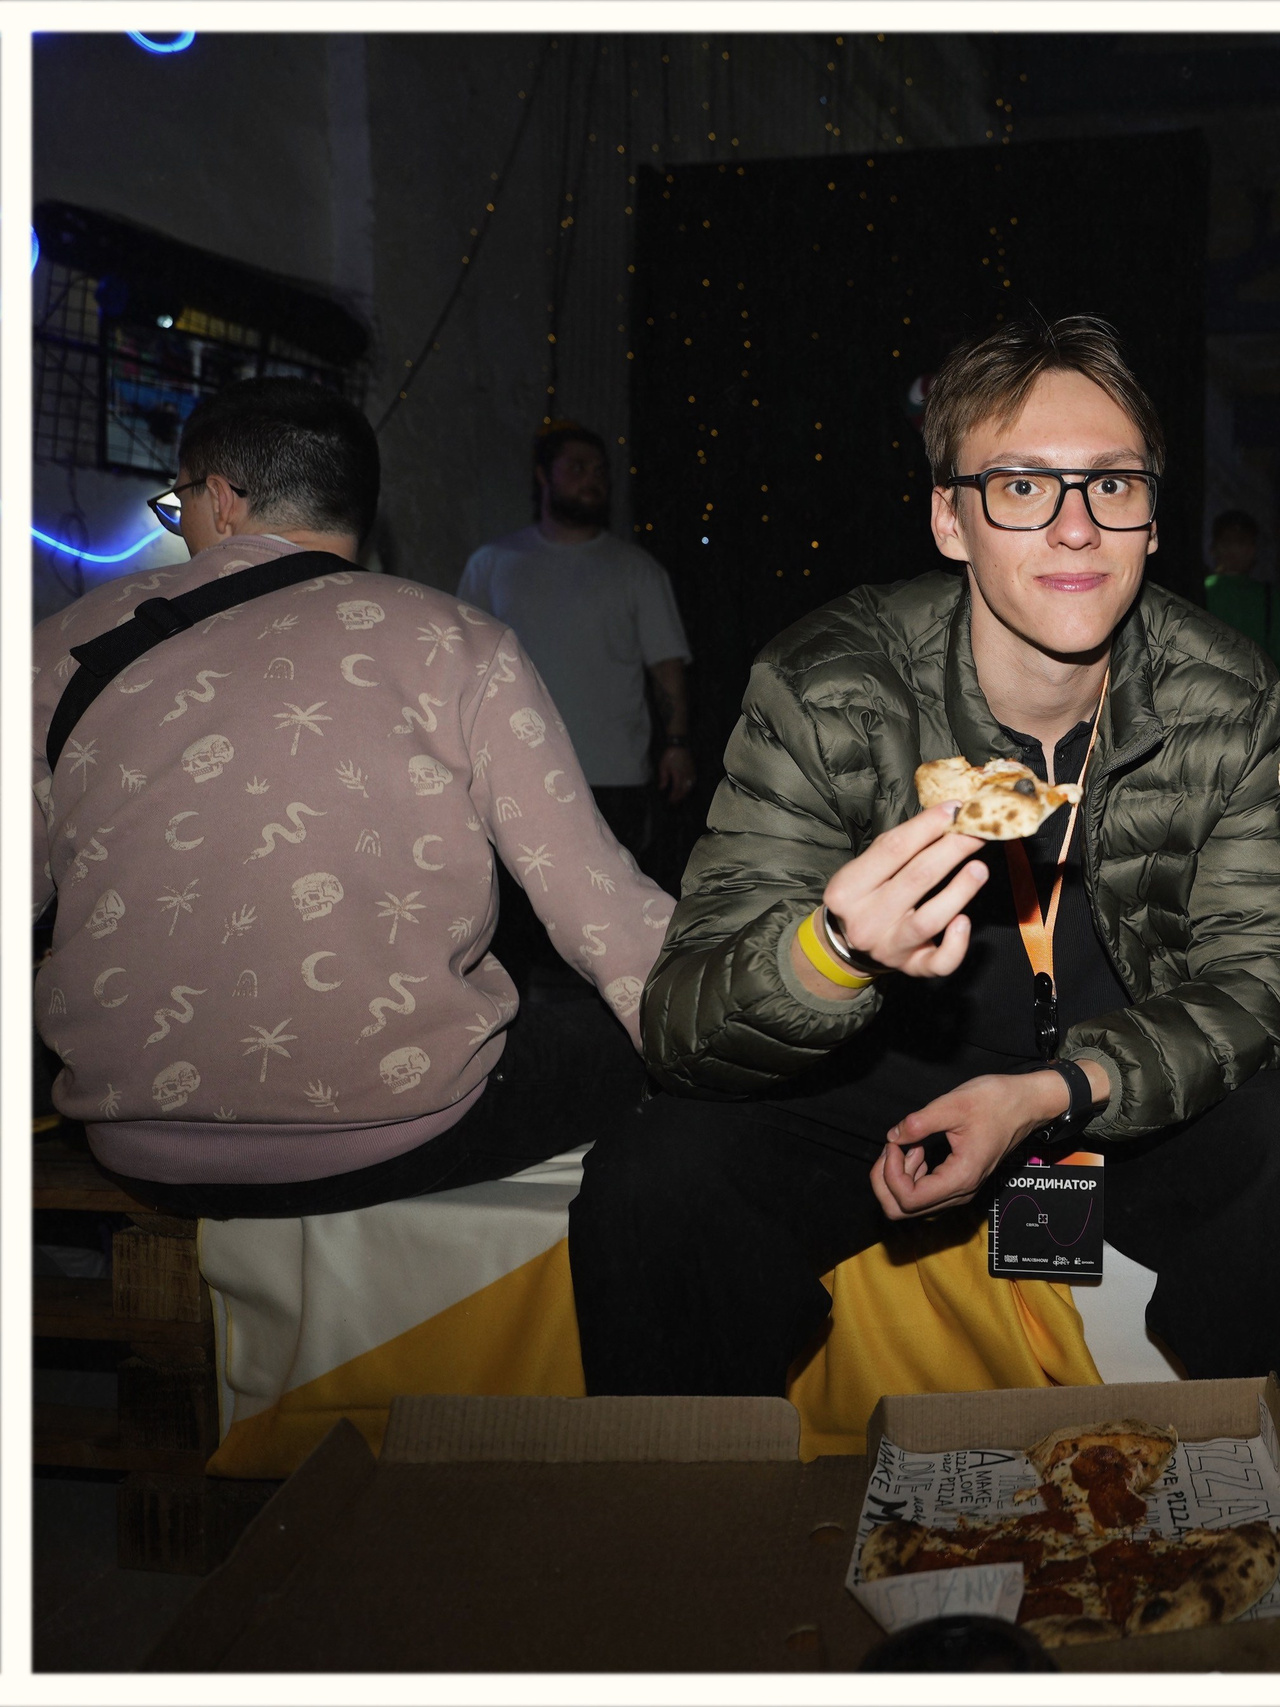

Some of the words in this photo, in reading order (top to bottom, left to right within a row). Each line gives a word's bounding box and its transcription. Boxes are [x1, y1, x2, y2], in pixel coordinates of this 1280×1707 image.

[1004, 1177, 1097, 1191] ООРДИНАТОР
[935, 1476, 956, 1508] PIZZA
[959, 1473, 974, 1503] LOVE
[973, 1470, 993, 1505] MAKE
[1164, 1491, 1190, 1536] PIZZA
